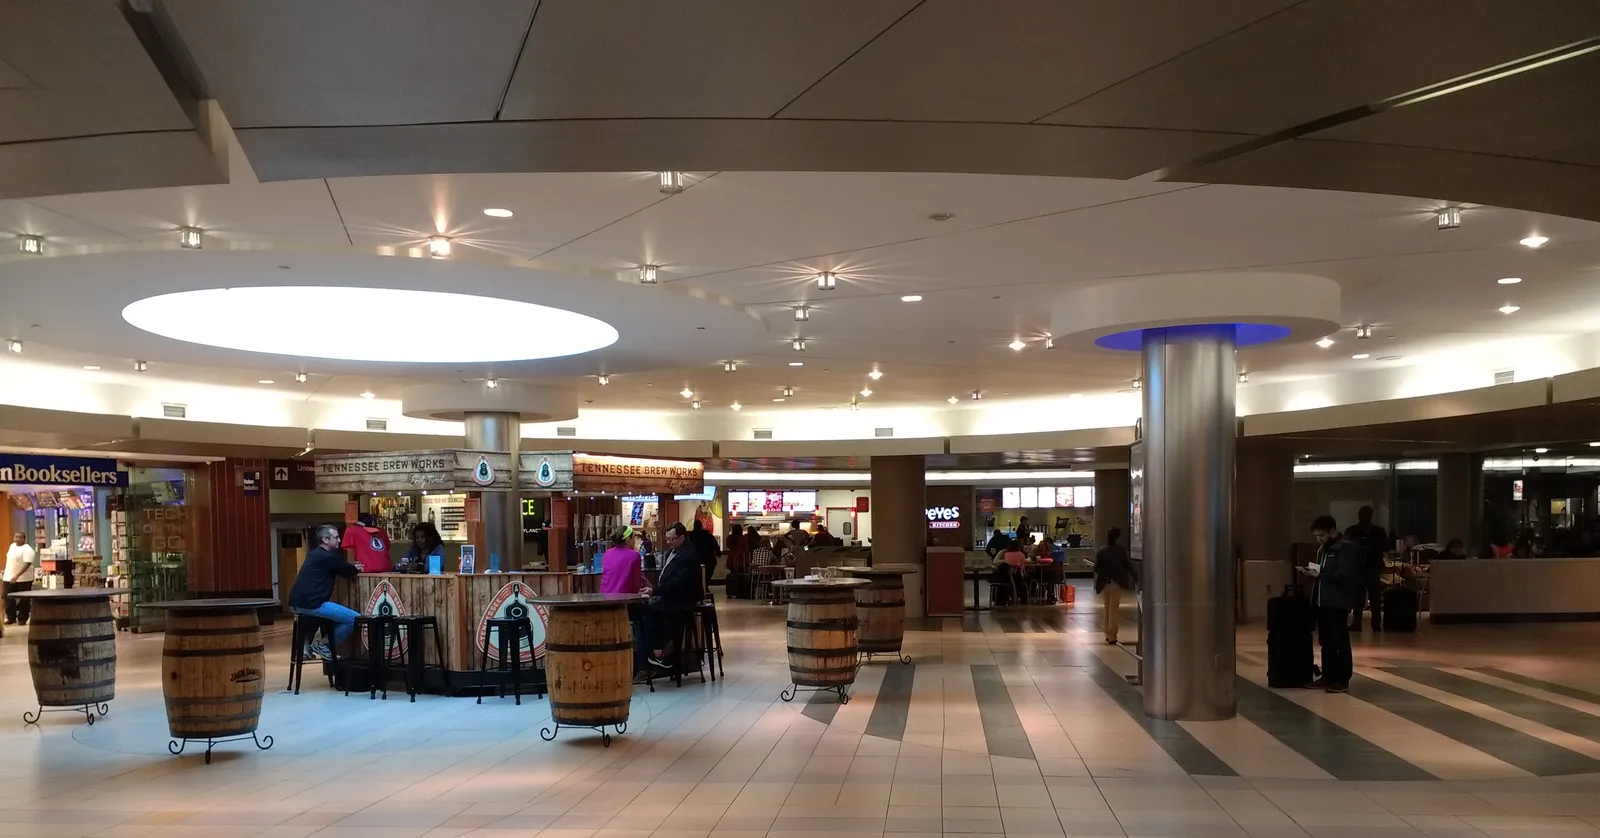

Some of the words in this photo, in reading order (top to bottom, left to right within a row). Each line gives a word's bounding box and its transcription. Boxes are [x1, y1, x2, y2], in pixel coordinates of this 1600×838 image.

[322, 461, 380, 473] TENNESSEE
[383, 460, 408, 471] BREW
[410, 459, 445, 470] WORKS
[580, 463, 641, 475] TENNESSEE
[644, 465, 668, 476] BREW
[669, 466, 698, 477] WORKS
[14, 464, 117, 484] Booksellers
[143, 508, 188, 520] TECH
